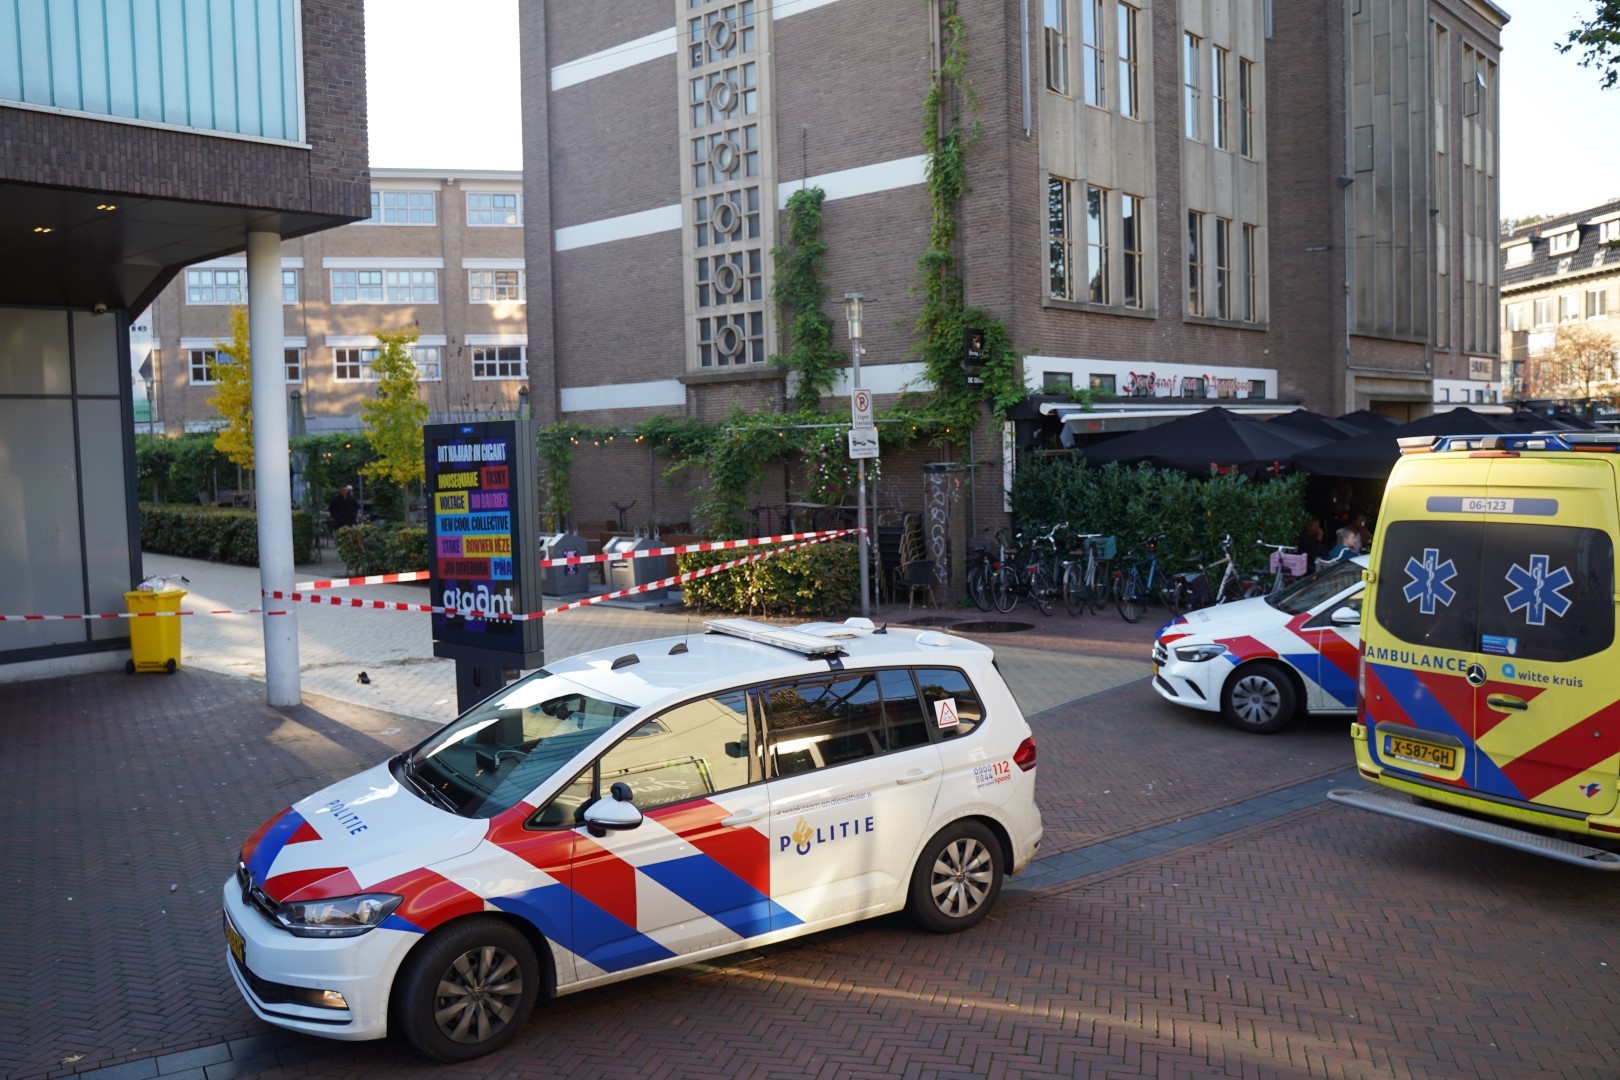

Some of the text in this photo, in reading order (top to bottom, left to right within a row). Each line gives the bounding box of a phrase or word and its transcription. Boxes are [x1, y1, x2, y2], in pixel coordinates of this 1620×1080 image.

[437, 443, 506, 462] DIT NAJAAR IN GIGANT
[438, 471, 479, 489] HOUSEQUAKE
[440, 492, 508, 510] VOLTAGE NO BARRIER
[1469, 500, 1506, 511] 06-123
[440, 515, 509, 532] NEW COOL COLLECTIVE
[465, 538, 494, 553] ROWWEN
[1366, 646, 1467, 672] AMBULANCE
[1518, 670, 1583, 688] witte kruis
[1394, 740, 1449, 765] X-587-GH
[974, 760, 1010, 776] 0900 112
[830, 791, 866, 806] dienstbaar
[323, 799, 368, 836] POLITIE
[780, 816, 874, 856] POLITIE
